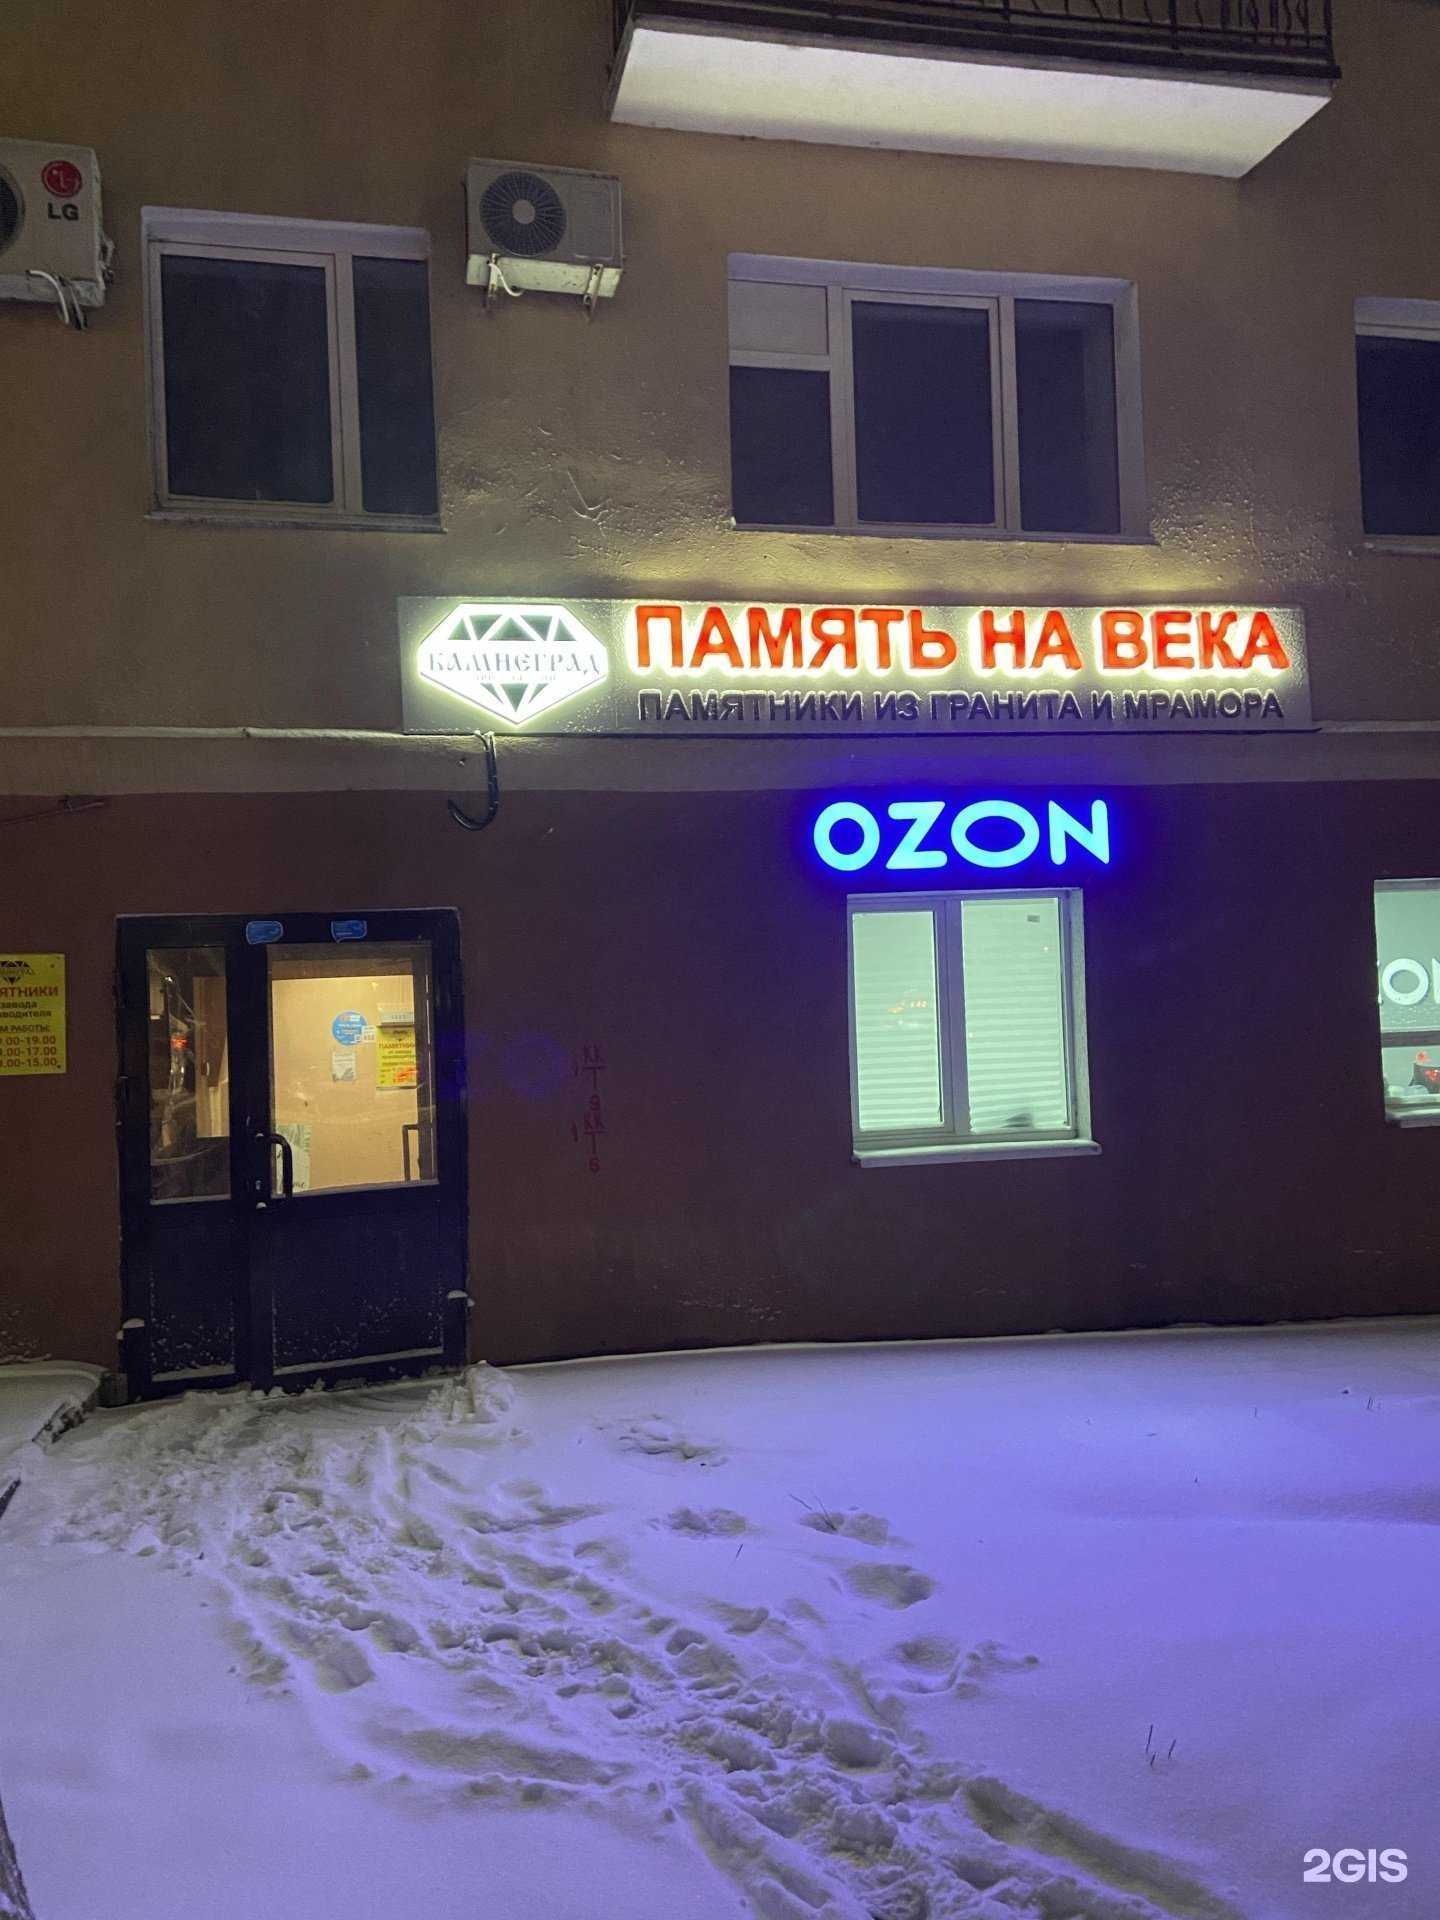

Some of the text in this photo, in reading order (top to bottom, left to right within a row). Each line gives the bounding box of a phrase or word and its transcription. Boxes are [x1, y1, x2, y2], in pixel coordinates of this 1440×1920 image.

[47, 203, 79, 221] LG
[634, 605, 1291, 670] ПАМЯТЬ НА ВЕКА
[637, 688, 1284, 721] ПАМЯТНИКИ ИЗ ГРАНИТА И МРАМОРА
[813, 799, 1110, 871] OZON
[1382, 958, 1440, 1005] O
